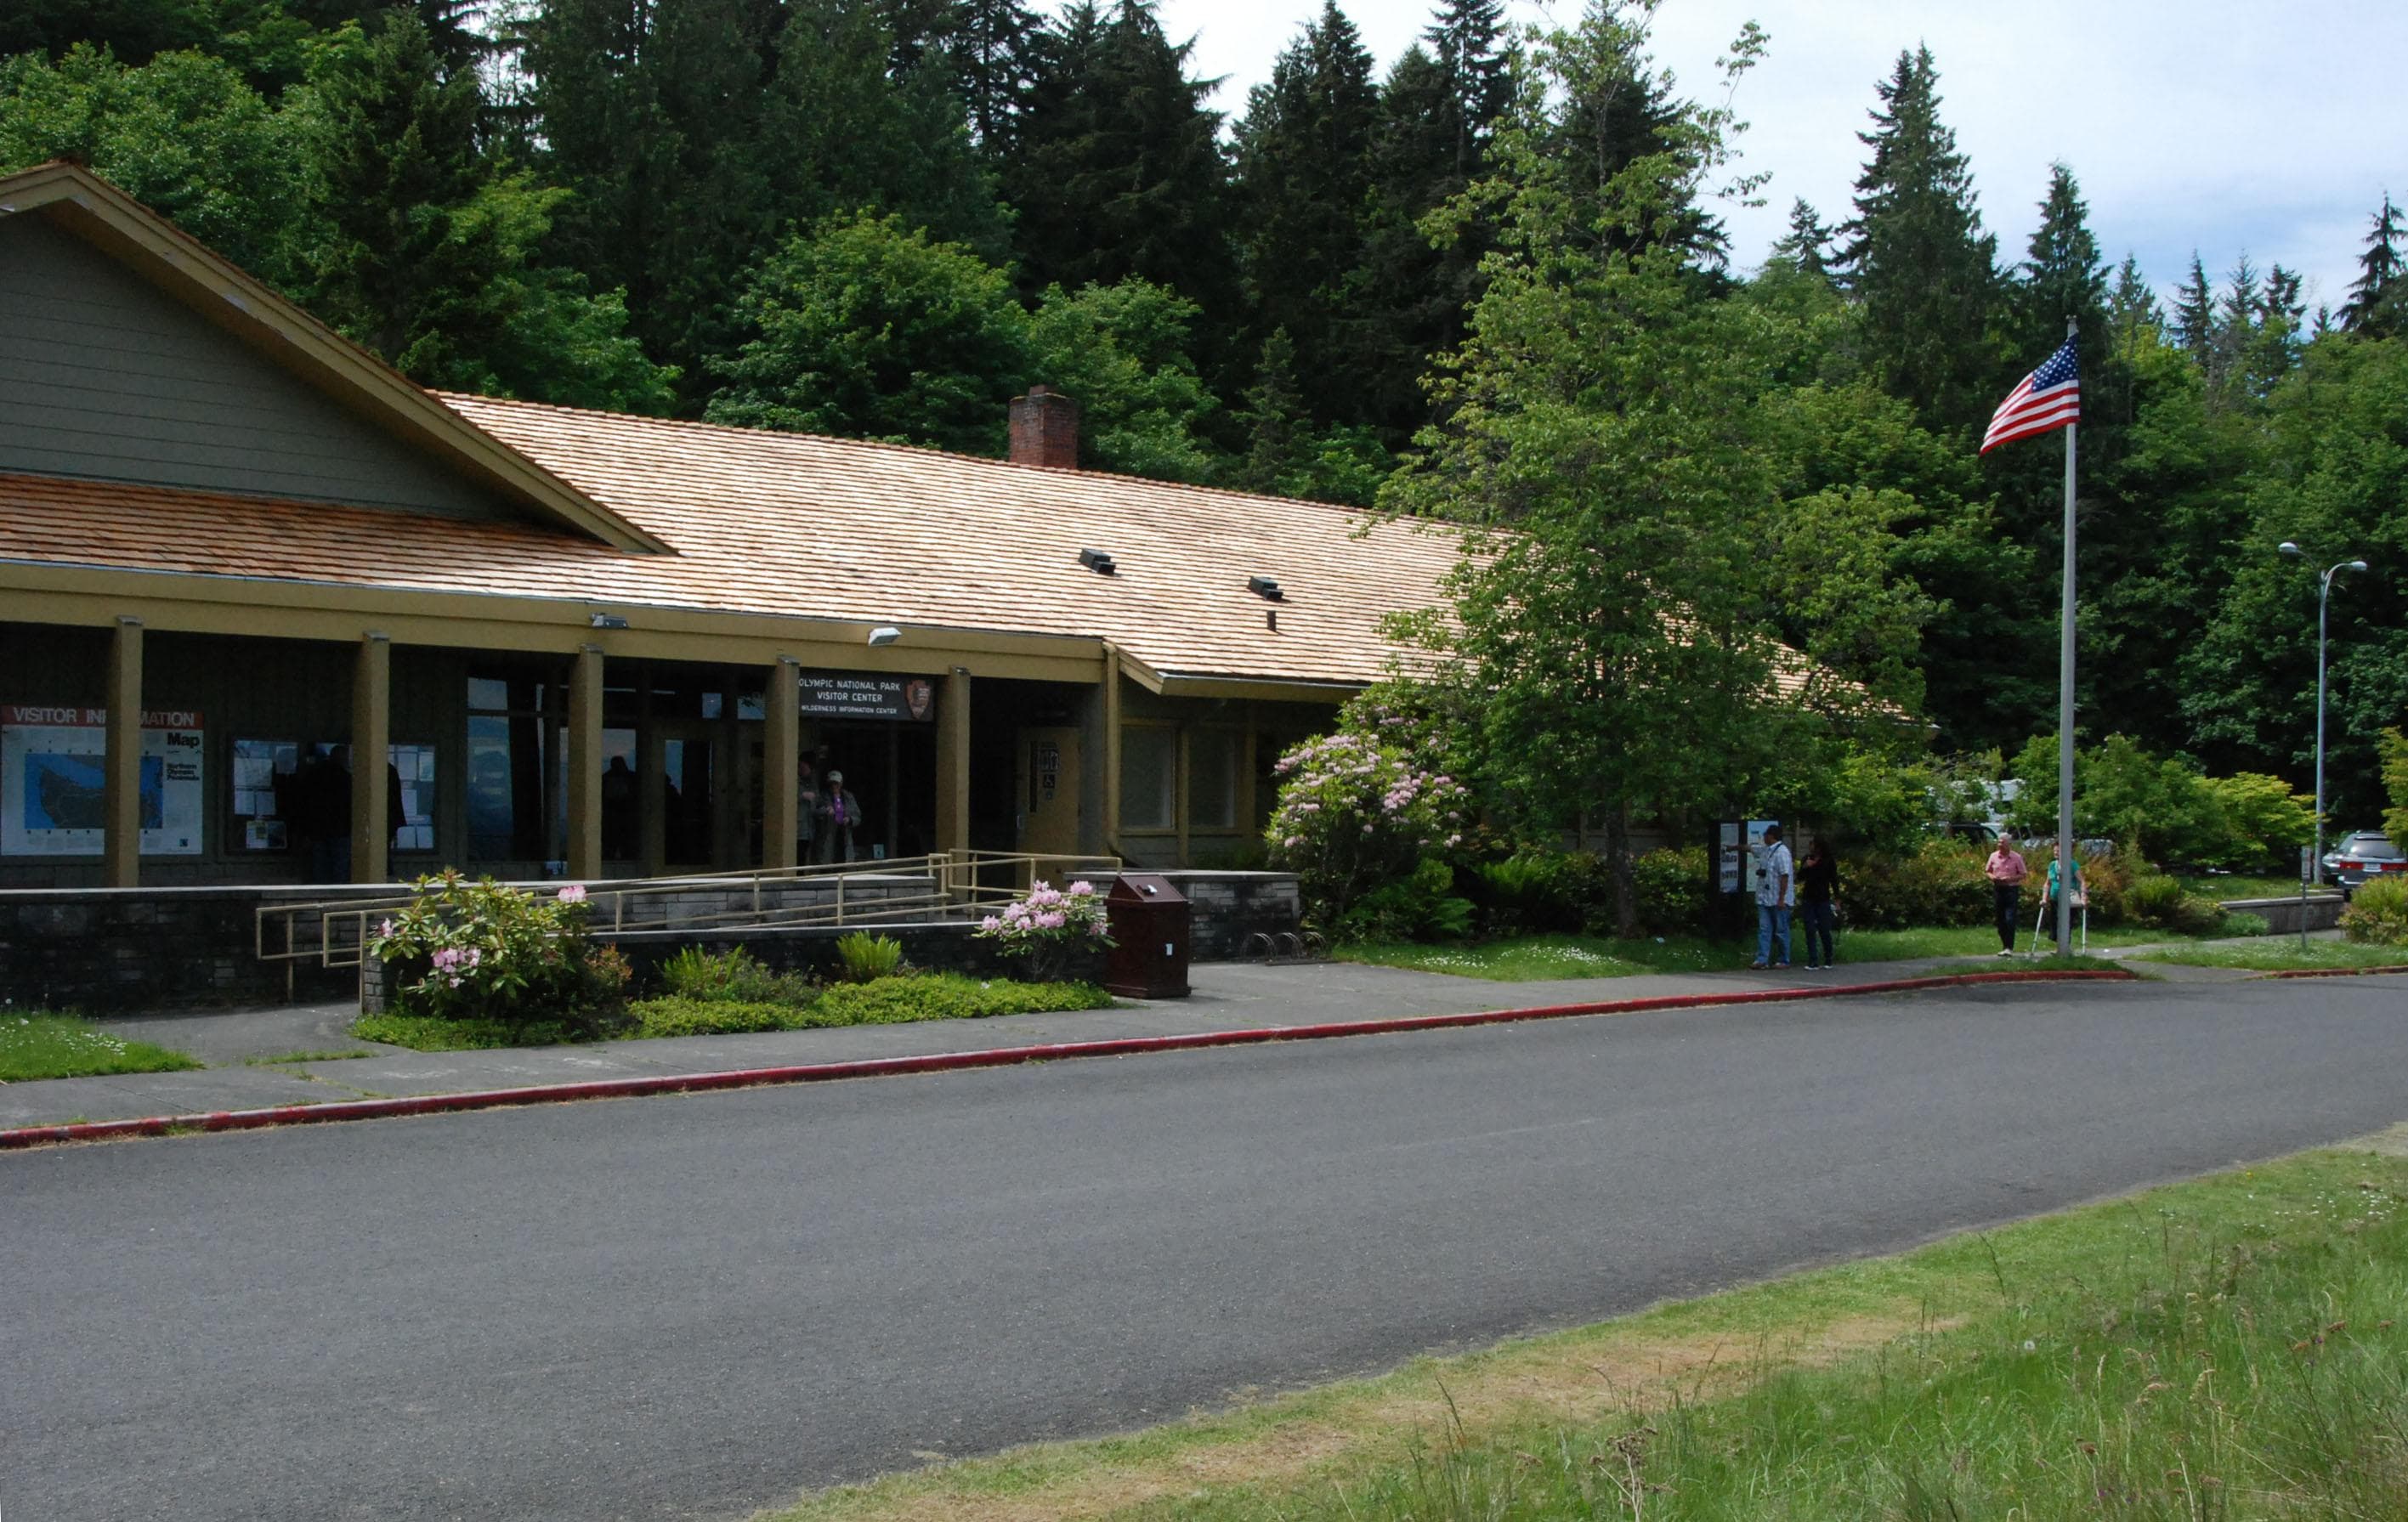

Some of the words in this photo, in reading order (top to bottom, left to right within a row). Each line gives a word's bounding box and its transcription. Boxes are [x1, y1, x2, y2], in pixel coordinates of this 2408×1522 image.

[798, 678, 833, 687] OLYMPIC
[836, 681, 875, 690] NATIONAL
[880, 682, 901, 692] PARK
[817, 691, 848, 701] VISITOR
[852, 693, 883, 703] CENTER
[13, 706, 77, 723] VISITOR
[801, 704, 837, 713] WILDERNESS
[838, 706, 875, 715] INFORMATION
[167, 732, 200, 748] Map
